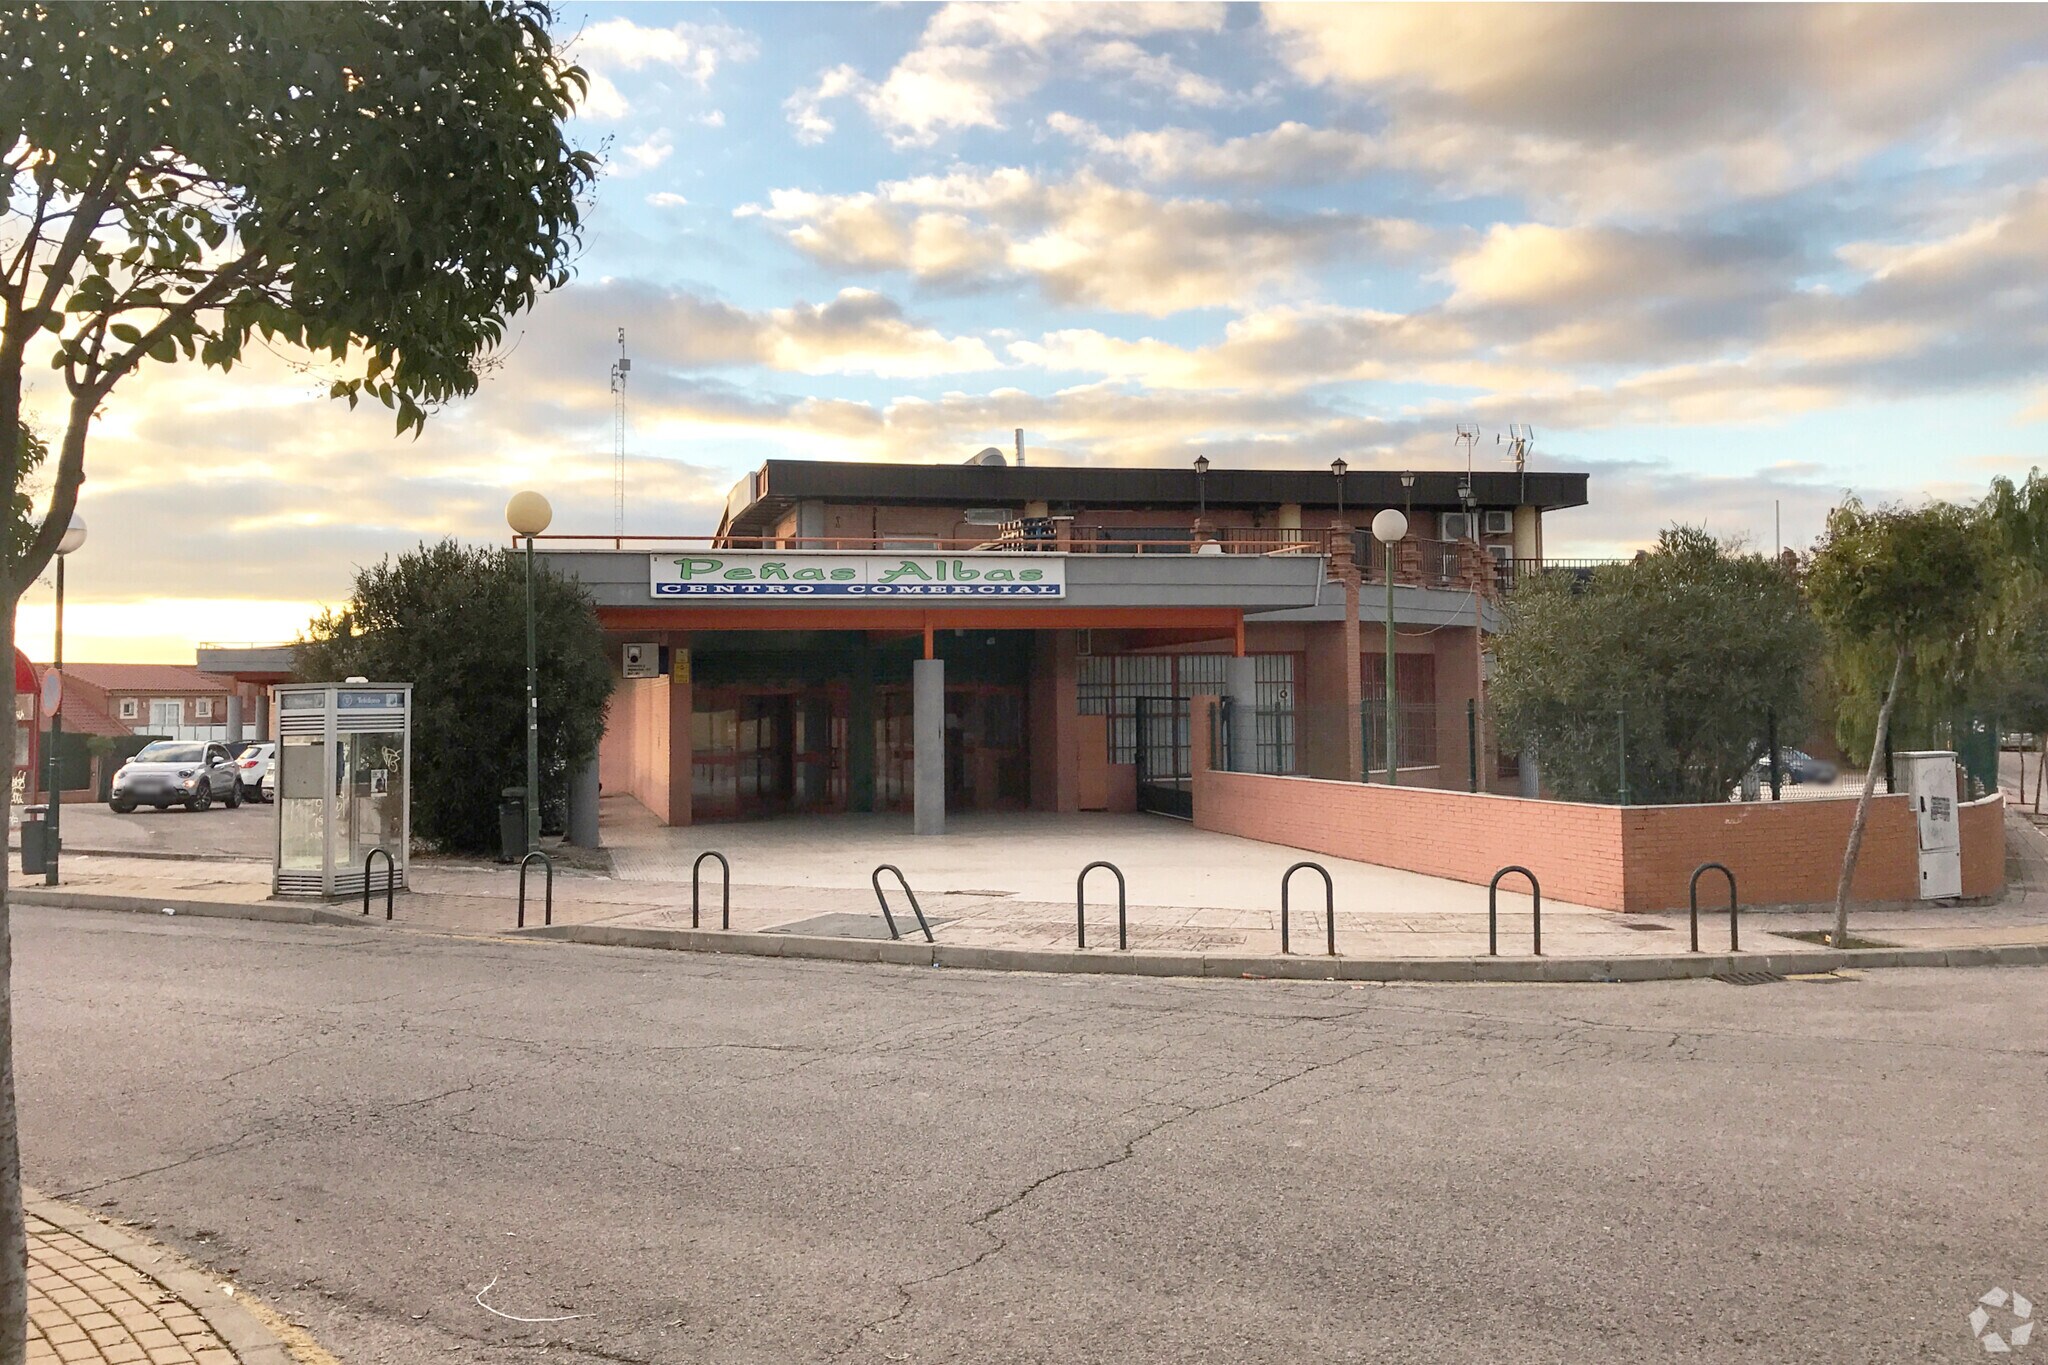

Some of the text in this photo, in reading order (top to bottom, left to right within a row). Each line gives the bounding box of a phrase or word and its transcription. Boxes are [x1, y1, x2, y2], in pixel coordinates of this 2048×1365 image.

[673, 557, 1044, 584] Peñas Albas
[661, 584, 1057, 594] CENTRO COMERCIAL
